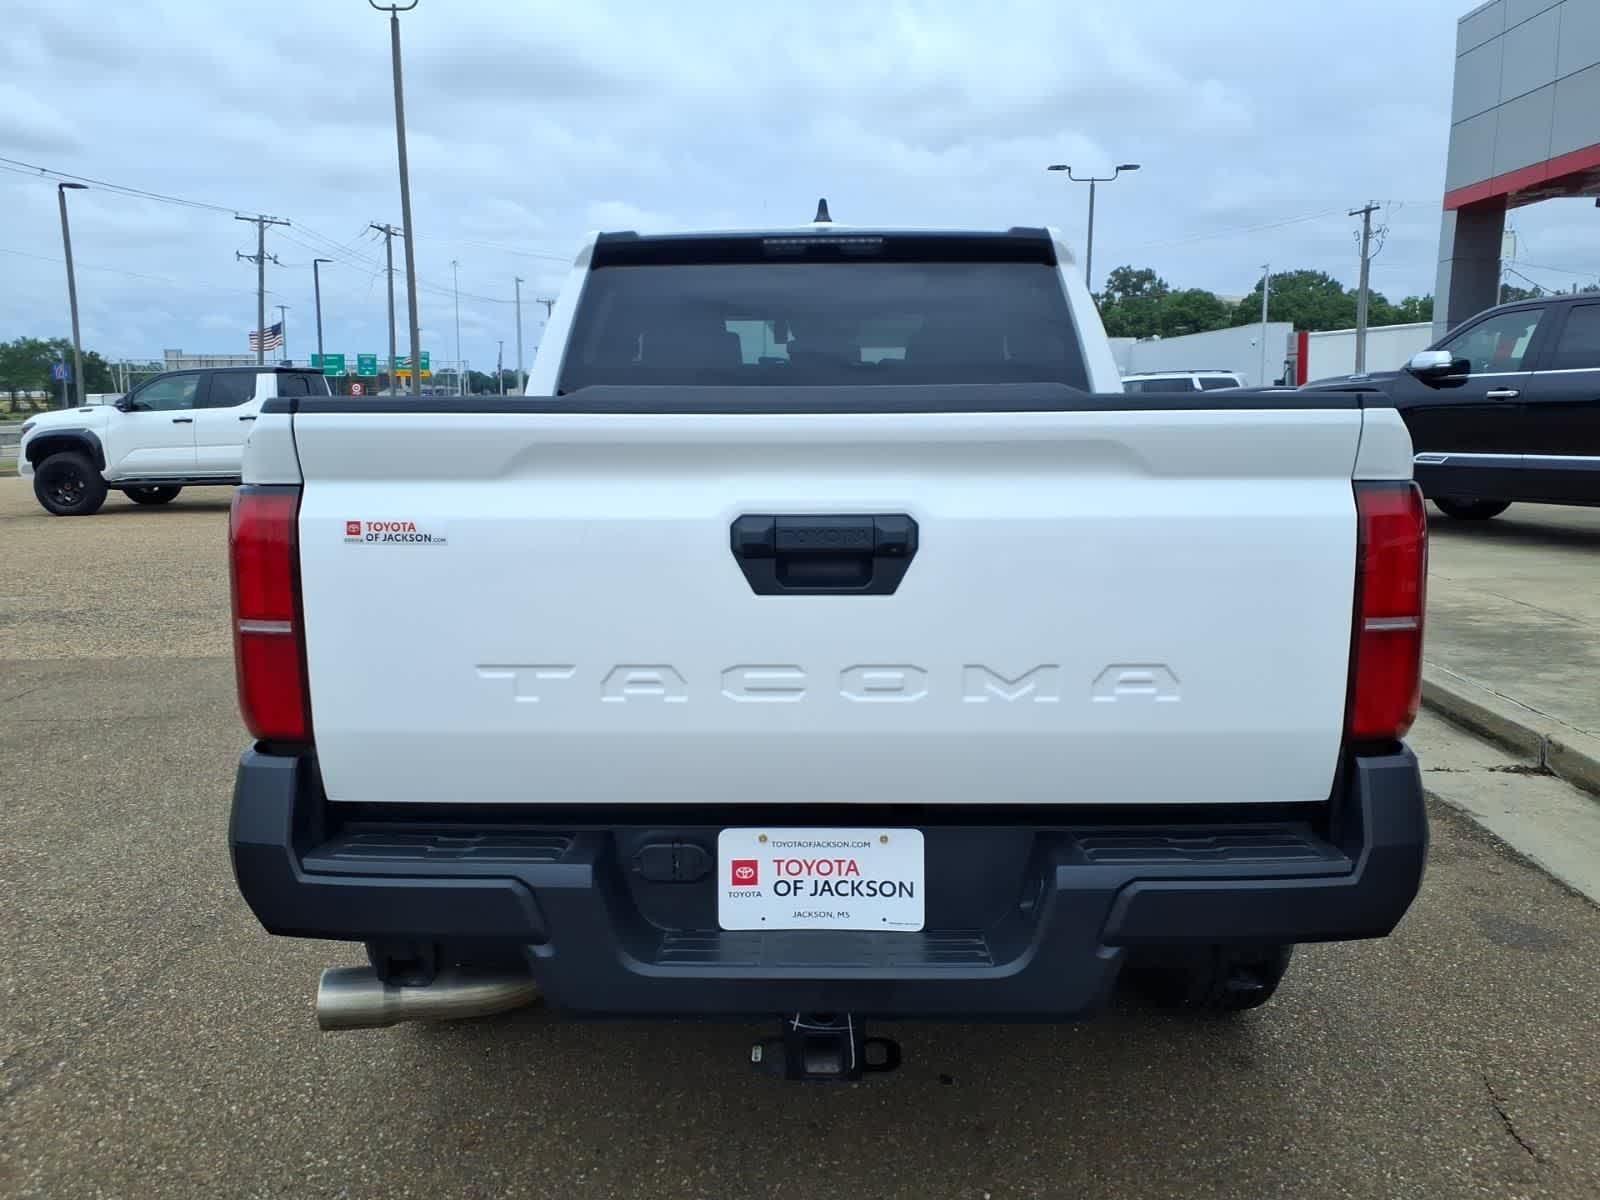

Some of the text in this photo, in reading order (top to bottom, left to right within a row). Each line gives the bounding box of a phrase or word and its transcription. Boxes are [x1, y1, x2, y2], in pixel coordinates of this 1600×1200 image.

[366, 521, 416, 532] TOYOTA
[366, 533, 380, 543] OF
[475, 664, 1182, 701] TACOMA
[773, 859, 860, 876] TOYOTA
[773, 880, 914, 898] OF JACKSON
